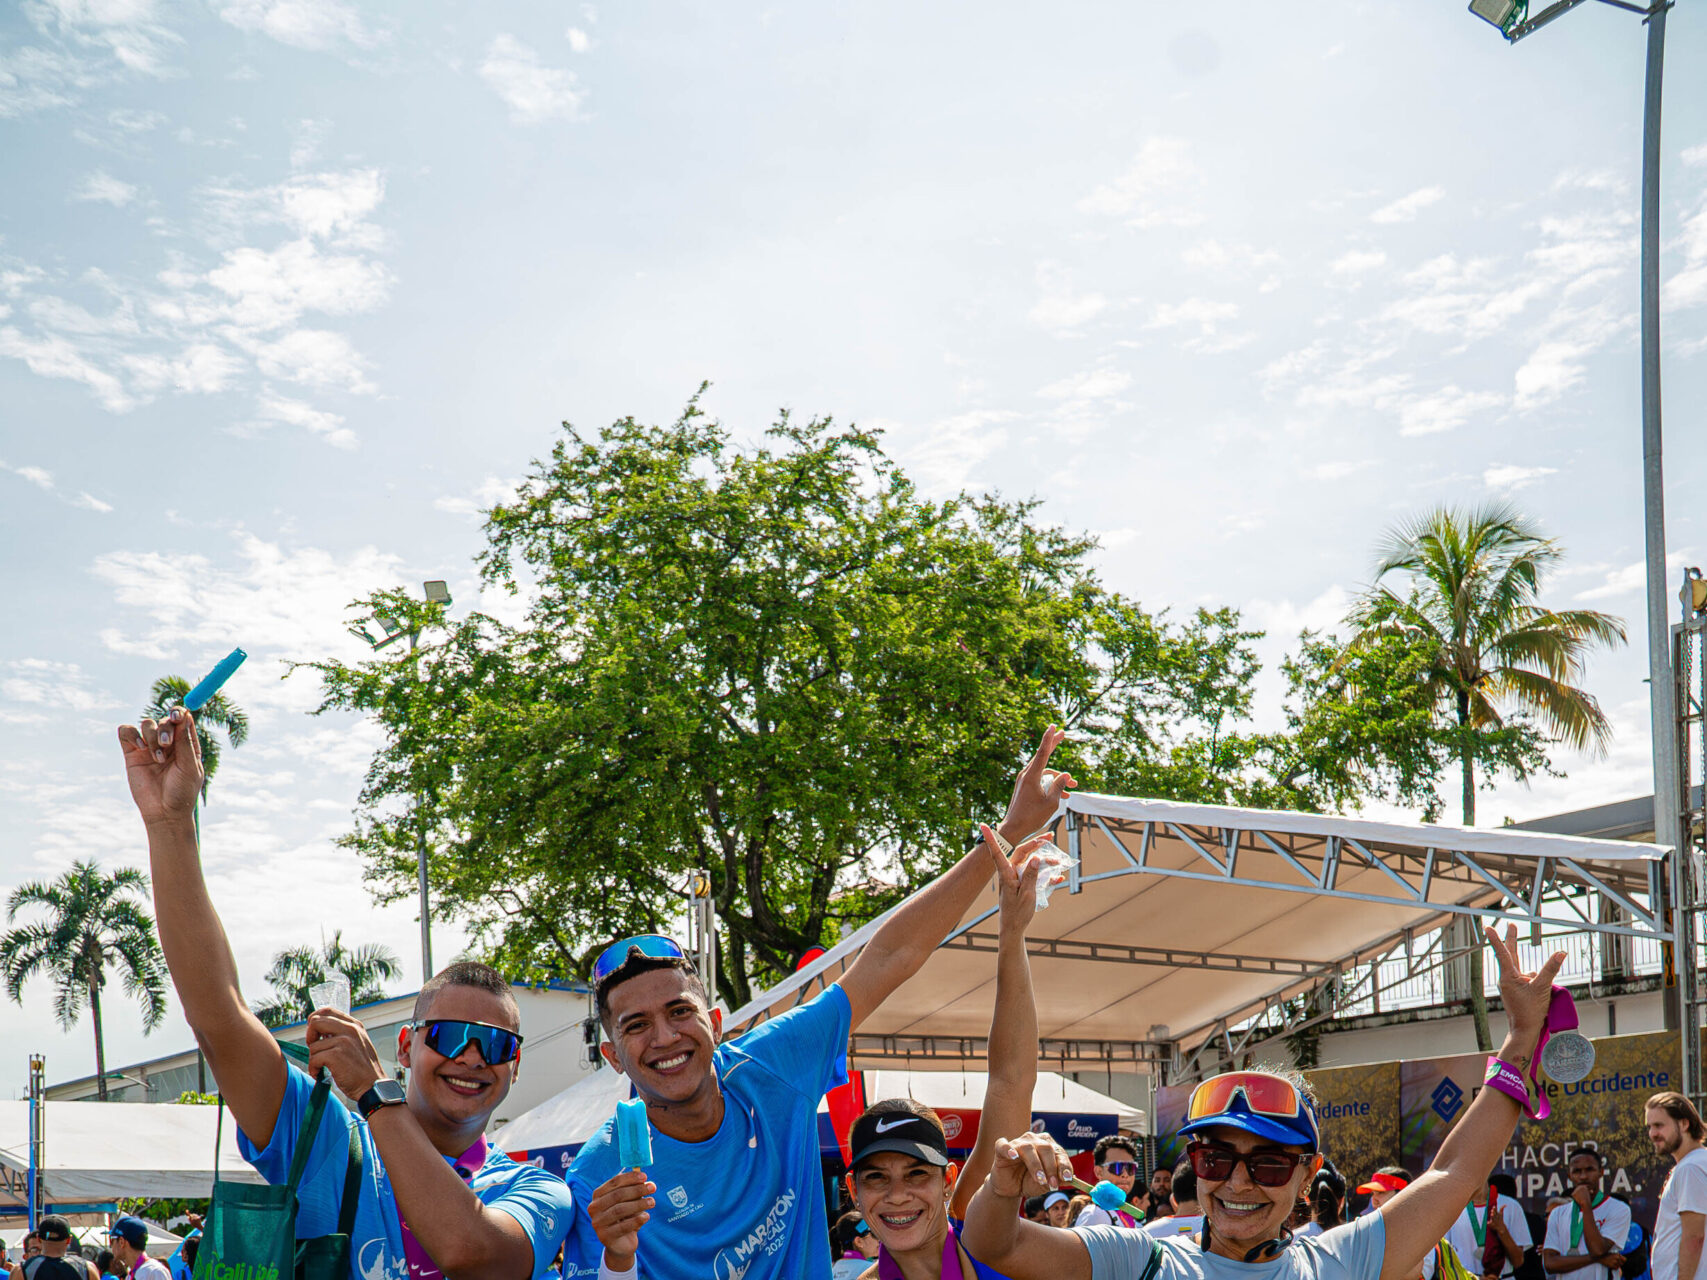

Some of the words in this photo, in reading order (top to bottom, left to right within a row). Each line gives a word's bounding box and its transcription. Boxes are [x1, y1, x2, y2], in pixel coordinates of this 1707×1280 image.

[1564, 1072, 1669, 1096] Occidente
[1318, 1100, 1370, 1120] idente
[735, 1188, 795, 1261] MARATÓN
[768, 1220, 786, 1241] CALI
